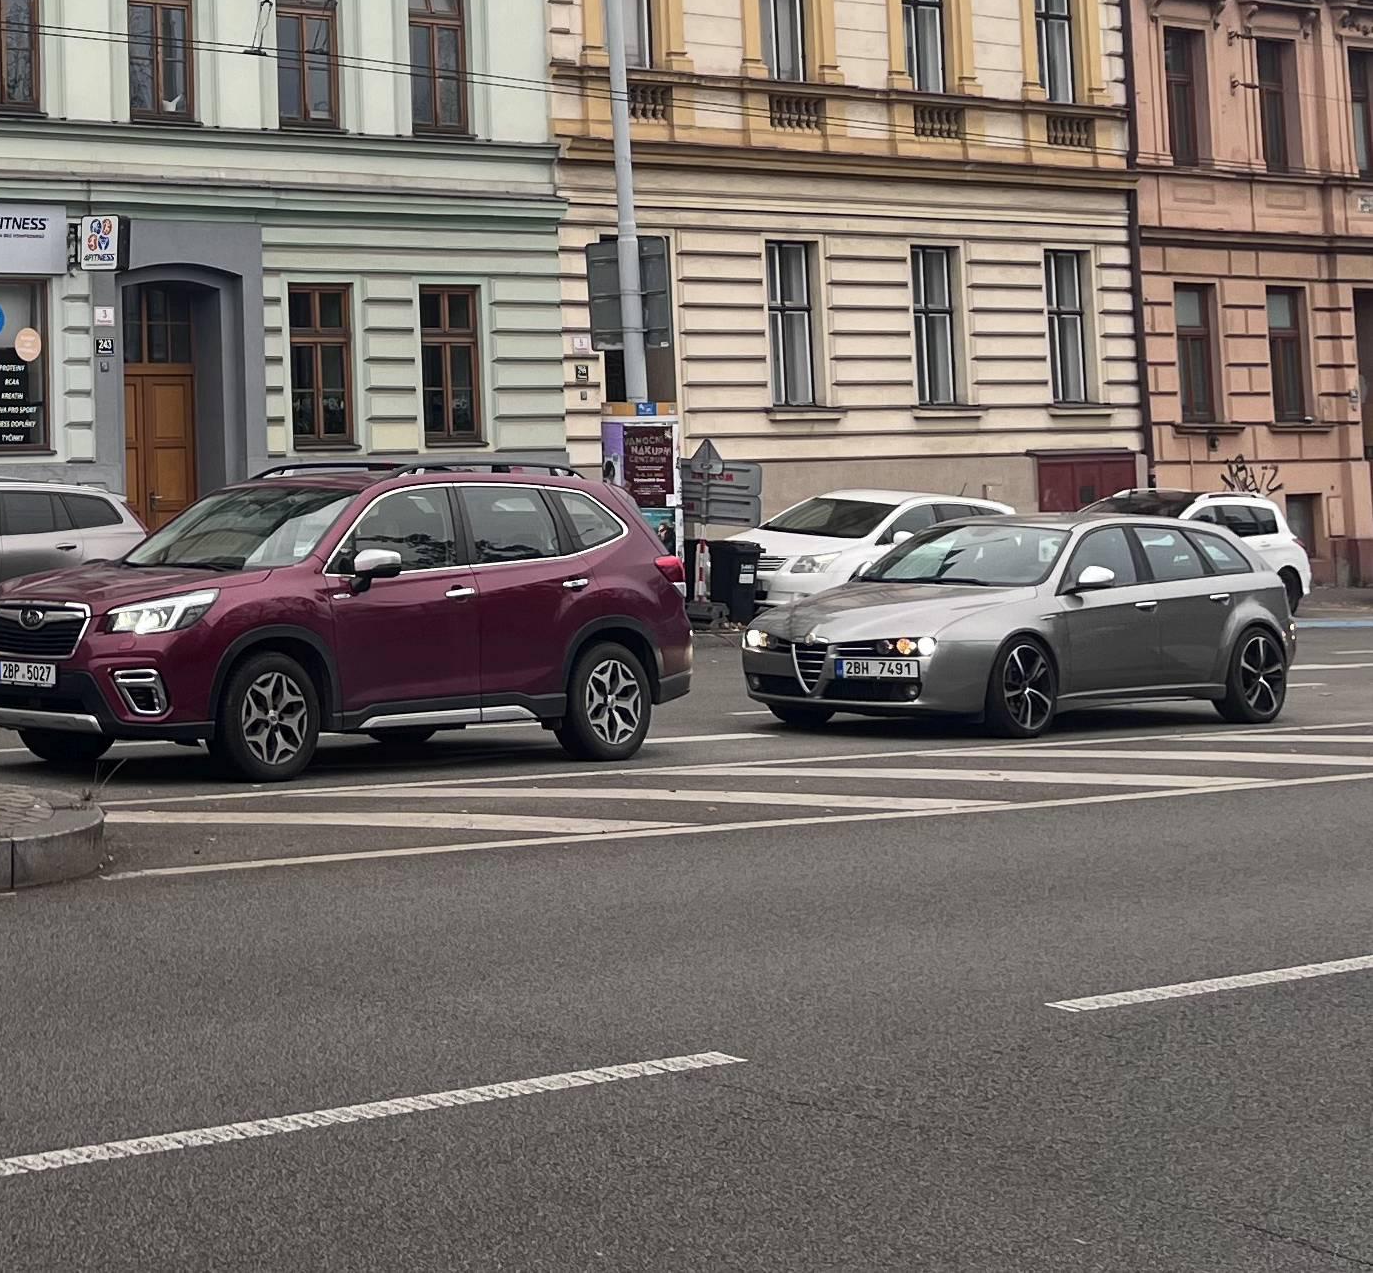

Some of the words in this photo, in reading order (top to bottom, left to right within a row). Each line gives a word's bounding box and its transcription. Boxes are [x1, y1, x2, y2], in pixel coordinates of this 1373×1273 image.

[98, 339, 112, 349] 243
[2, 663, 20, 679] 2BP
[26, 664, 52, 682] 5027
[845, 661, 869, 675] 2BH
[878, 661, 911, 676] 7491
